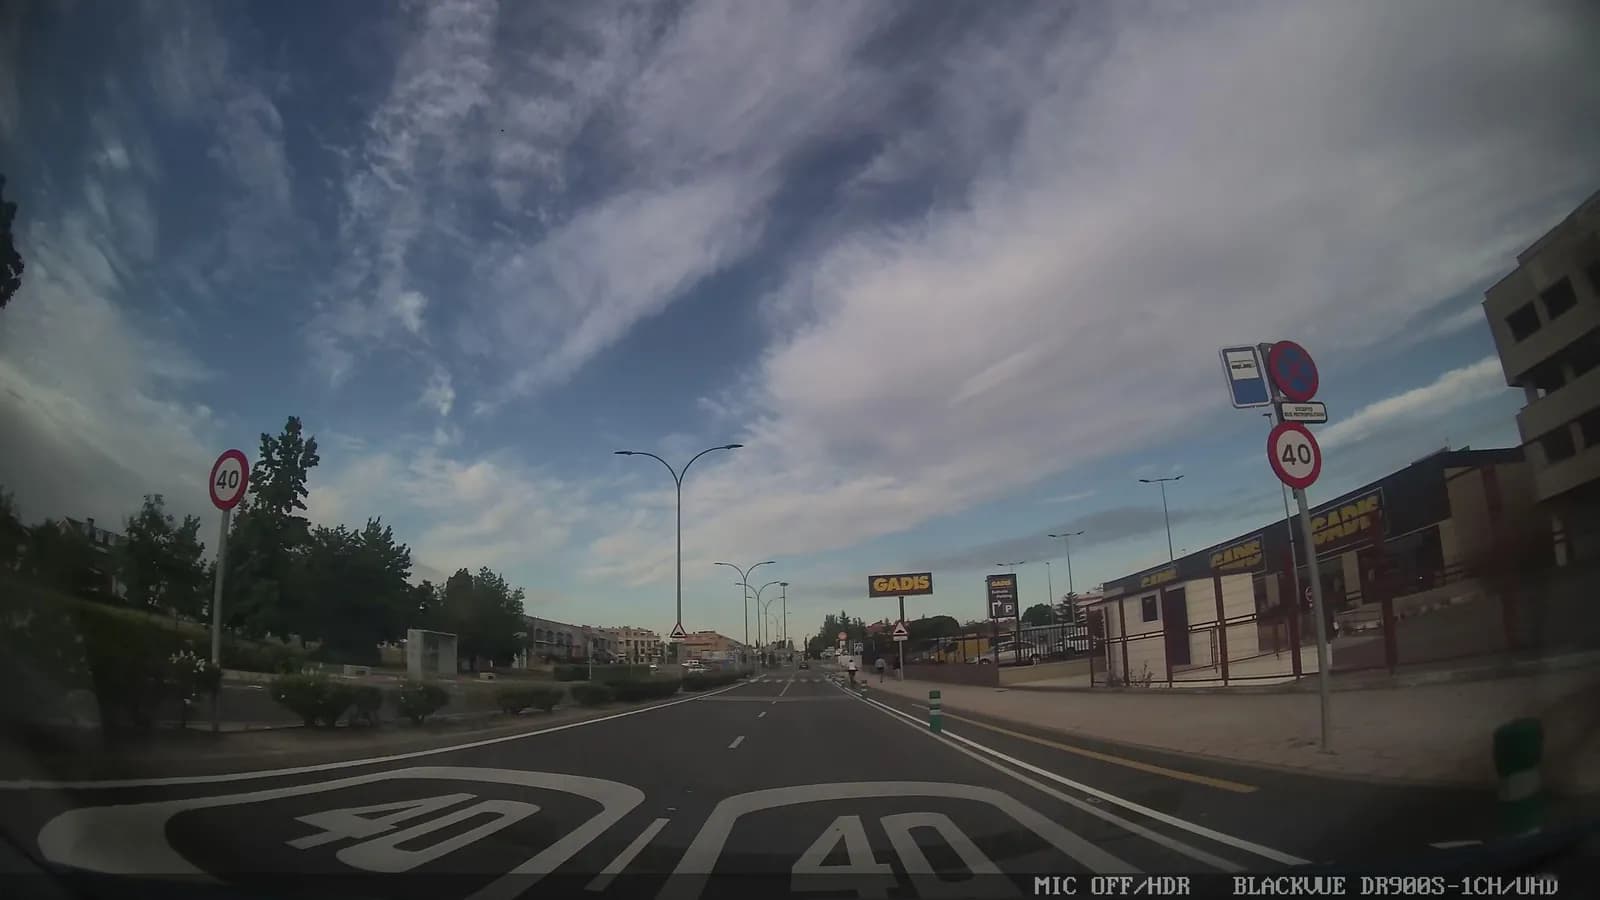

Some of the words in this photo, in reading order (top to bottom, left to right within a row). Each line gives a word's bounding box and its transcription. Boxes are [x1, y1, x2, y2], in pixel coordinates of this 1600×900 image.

[1282, 444, 1311, 465] 40
[216, 470, 239, 489] 40
[873, 576, 930, 592] GADIS
[284, 793, 541, 873] 40
[791, 812, 1026, 900] 40
